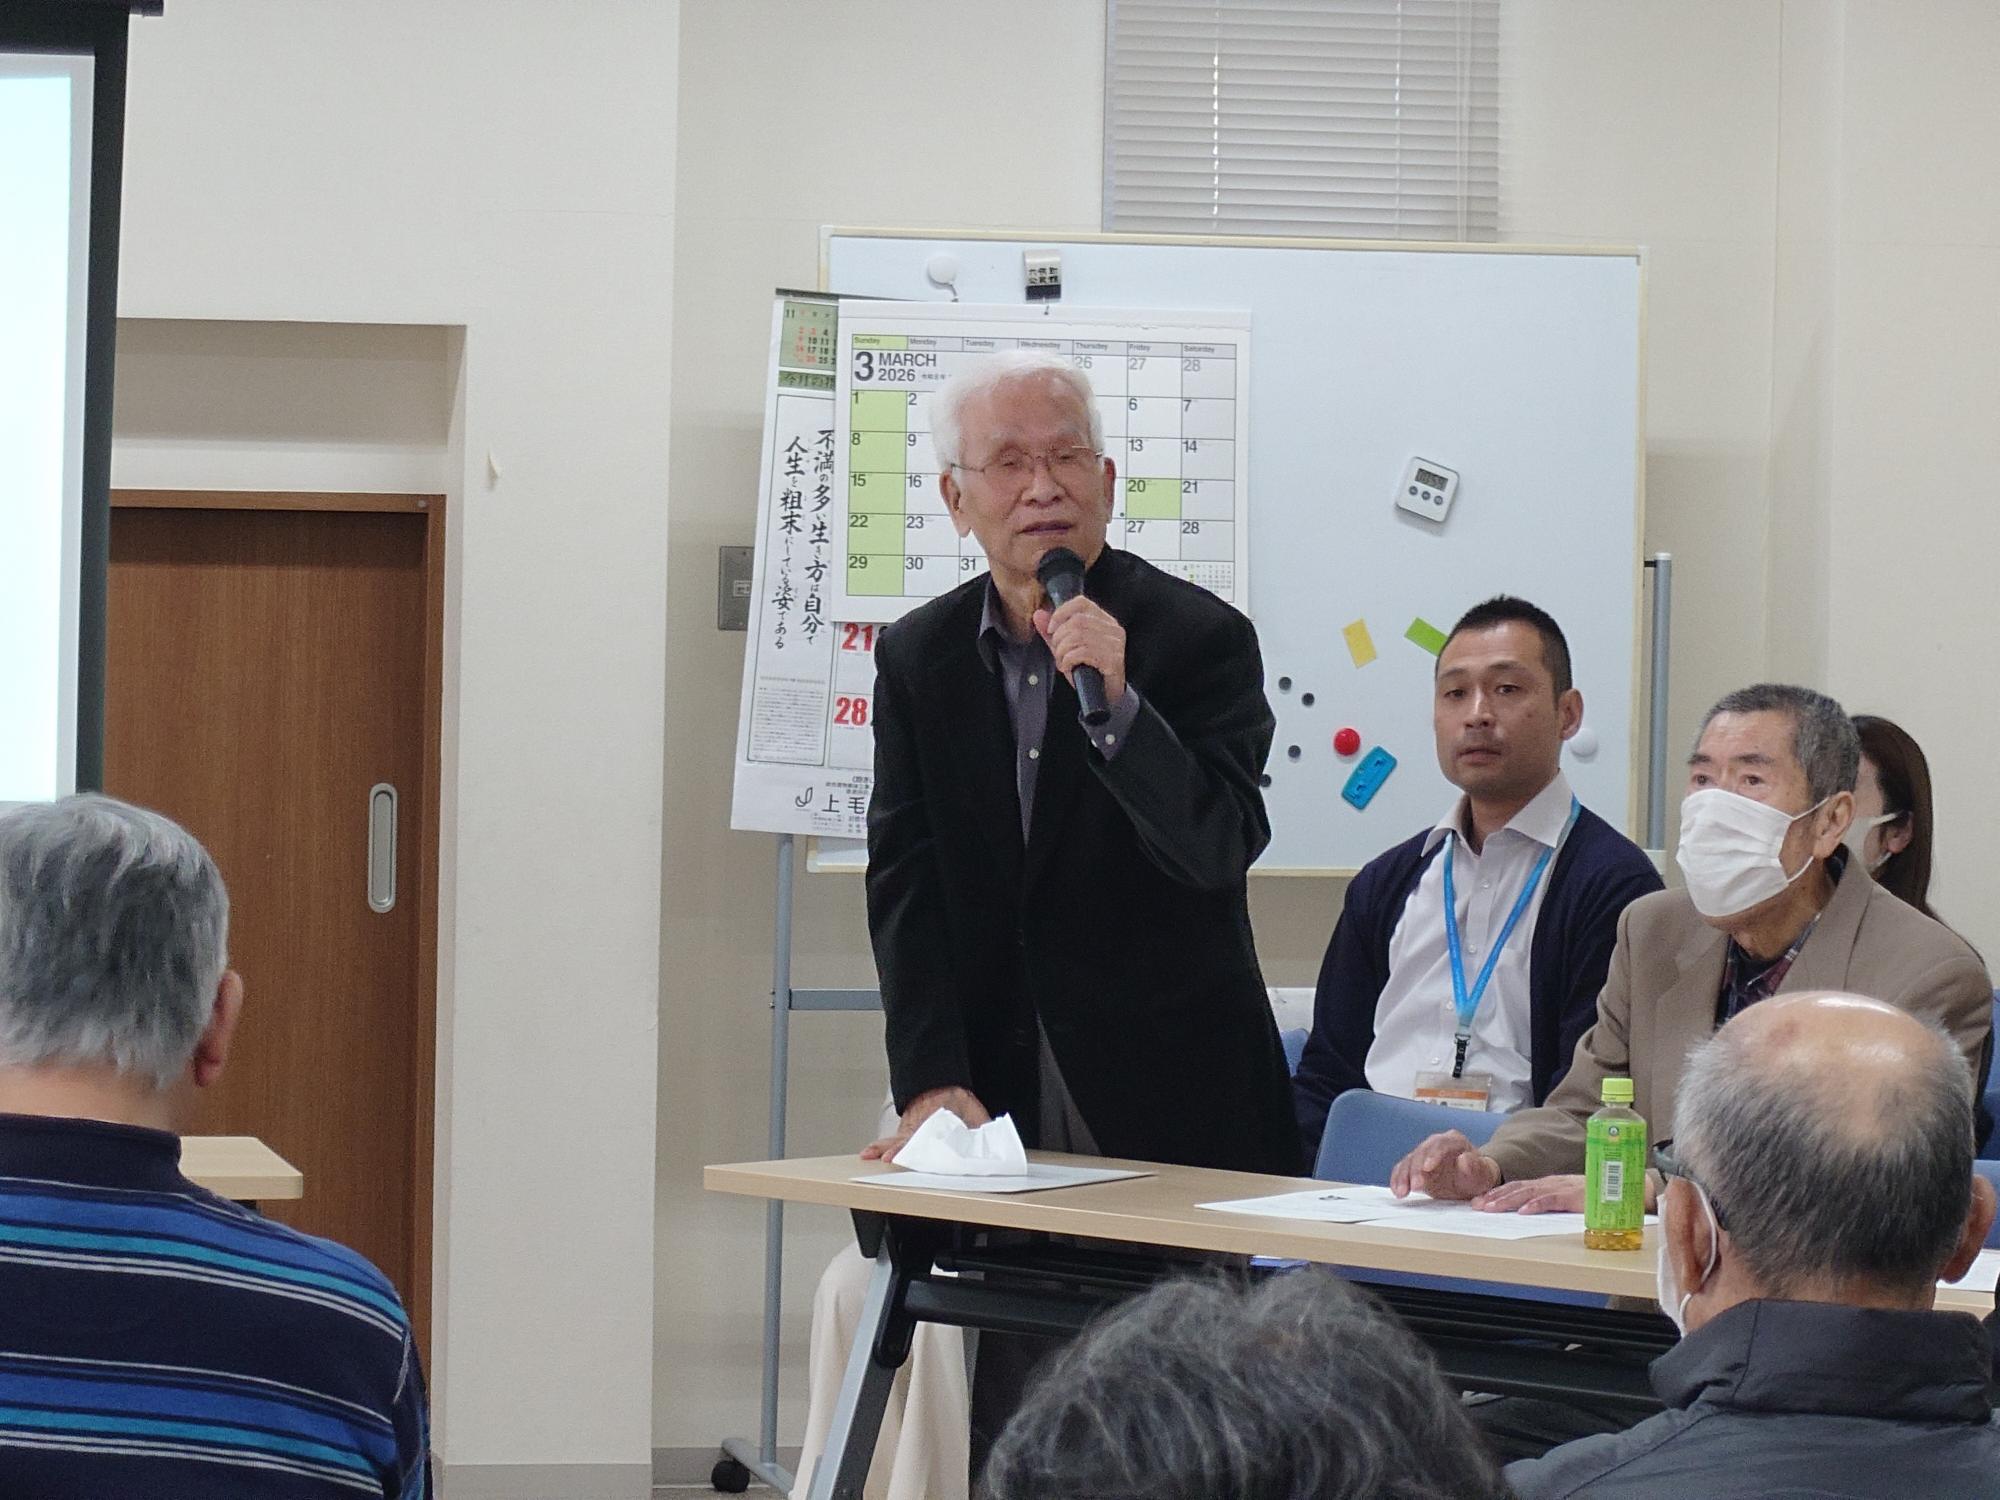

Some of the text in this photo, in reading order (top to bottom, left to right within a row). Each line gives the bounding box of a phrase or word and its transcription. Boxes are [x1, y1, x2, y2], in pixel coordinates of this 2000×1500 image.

[854, 337, 1215, 354] Sunday Monday Tuesday Wednesday Thursday Friday Saturday
[854, 351, 874, 381] 3
[879, 352, 937, 367] MARCH
[1075, 356, 1201, 372] 26 27 28
[878, 368, 916, 382] 2026
[853, 391, 1192, 413] 1 2 6 7
[851, 432, 1198, 453] 8 9 13 14
[850, 473, 1198, 494] 15 16 20 21
[849, 514, 1200, 535] 22 23 27 28
[849, 555, 976, 571] 29 30 31
[841, 622, 873, 652] 21
[834, 697, 868, 726] 28
[821, 793, 865, 815] 上毛
